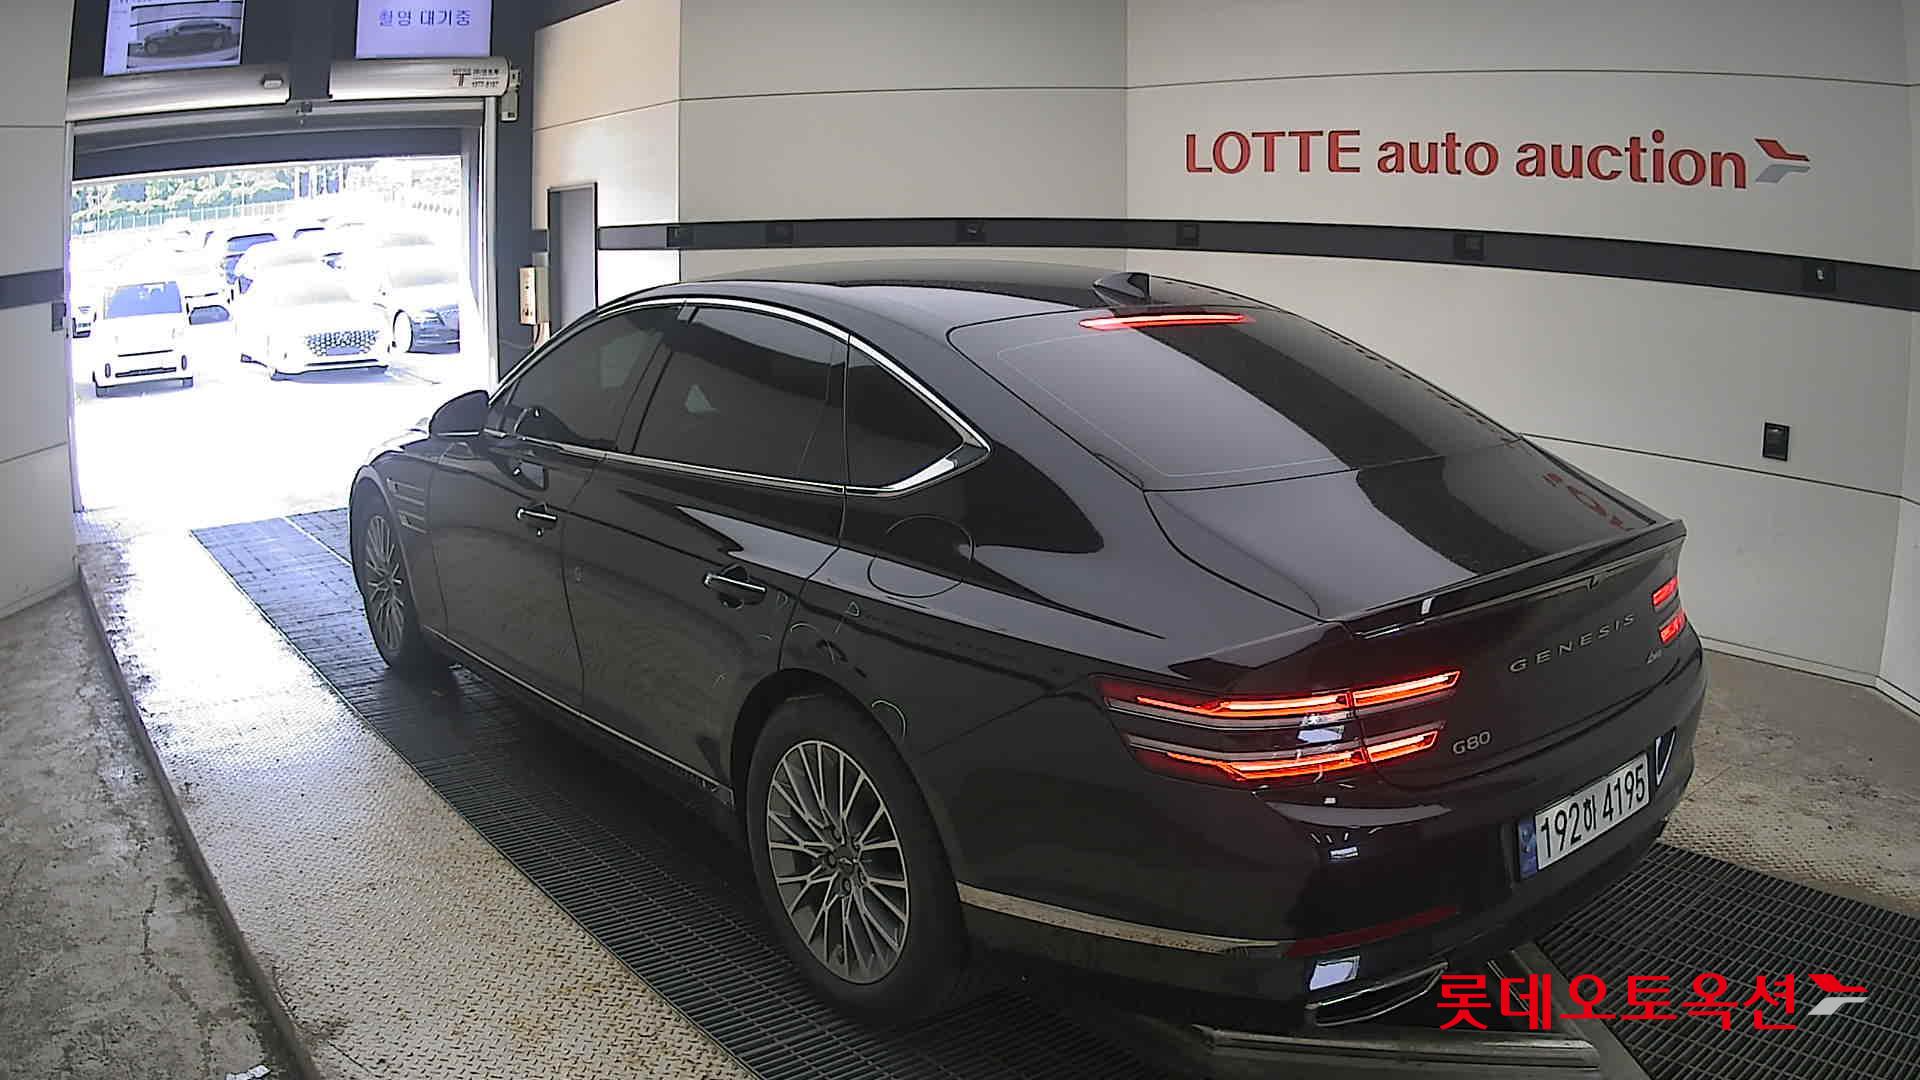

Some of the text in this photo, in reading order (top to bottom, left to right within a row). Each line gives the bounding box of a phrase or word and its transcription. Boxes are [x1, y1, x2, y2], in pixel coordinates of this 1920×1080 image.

[419, 10, 471, 26] 대기중
[1186, 129, 1747, 189] LOTTE auto auction
[1509, 613, 1636, 673] GENESIS
[1453, 731, 1491, 754] G80
[1602, 763, 1646, 824] 4195
